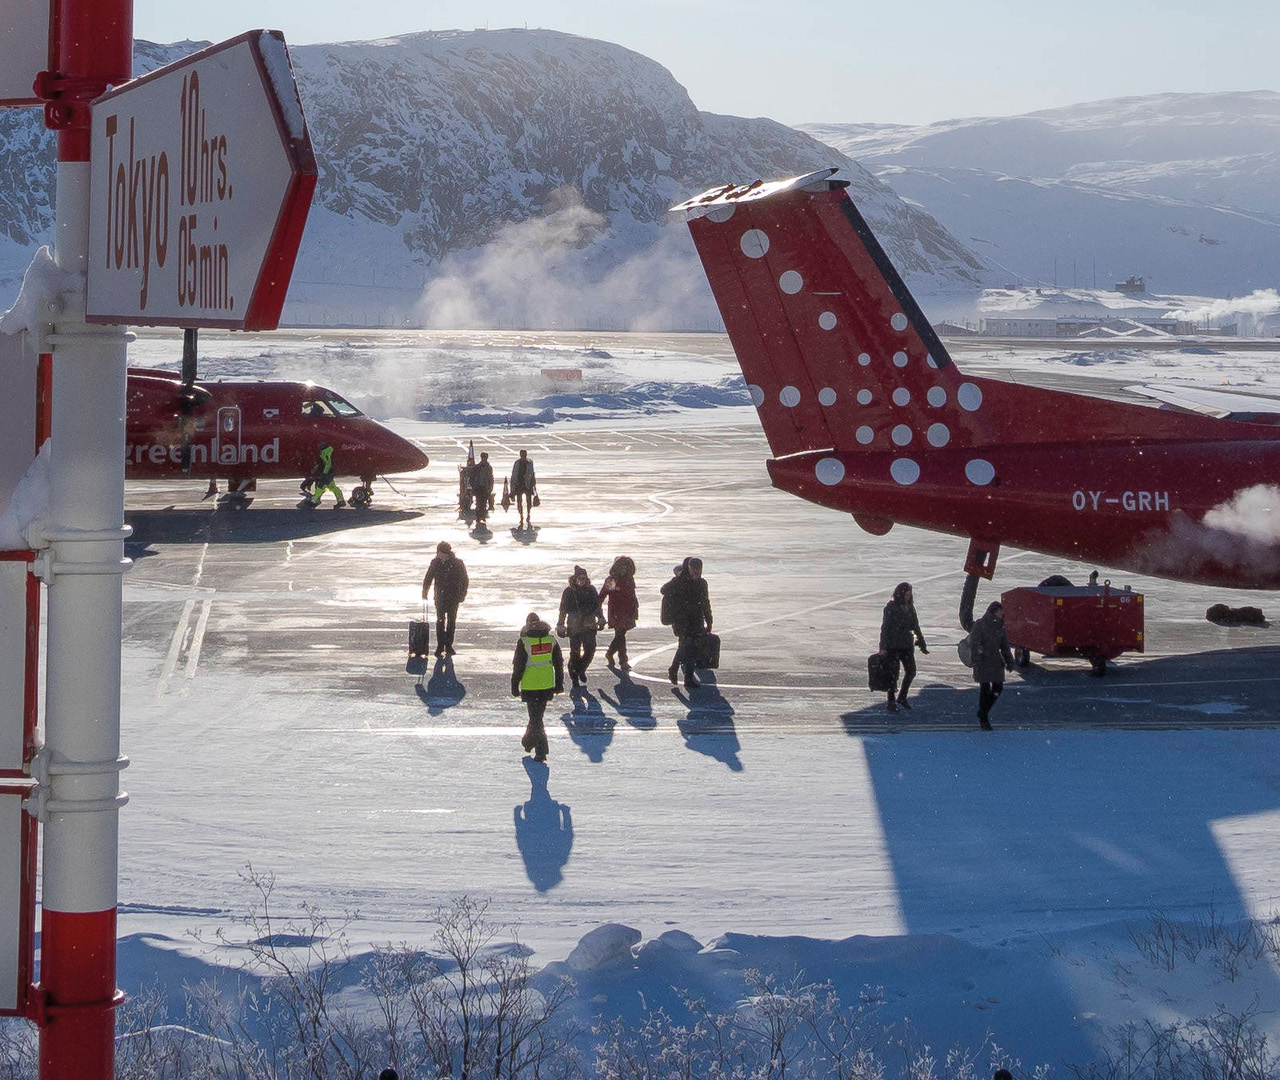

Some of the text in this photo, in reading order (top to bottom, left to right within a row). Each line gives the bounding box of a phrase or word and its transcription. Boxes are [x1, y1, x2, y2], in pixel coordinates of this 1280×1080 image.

[180, 69, 234, 207] 10 hrs.
[106, 114, 170, 311] Tokyo
[177, 214, 235, 313] 05 min.
[1072, 490, 1170, 511] OY-GRH
